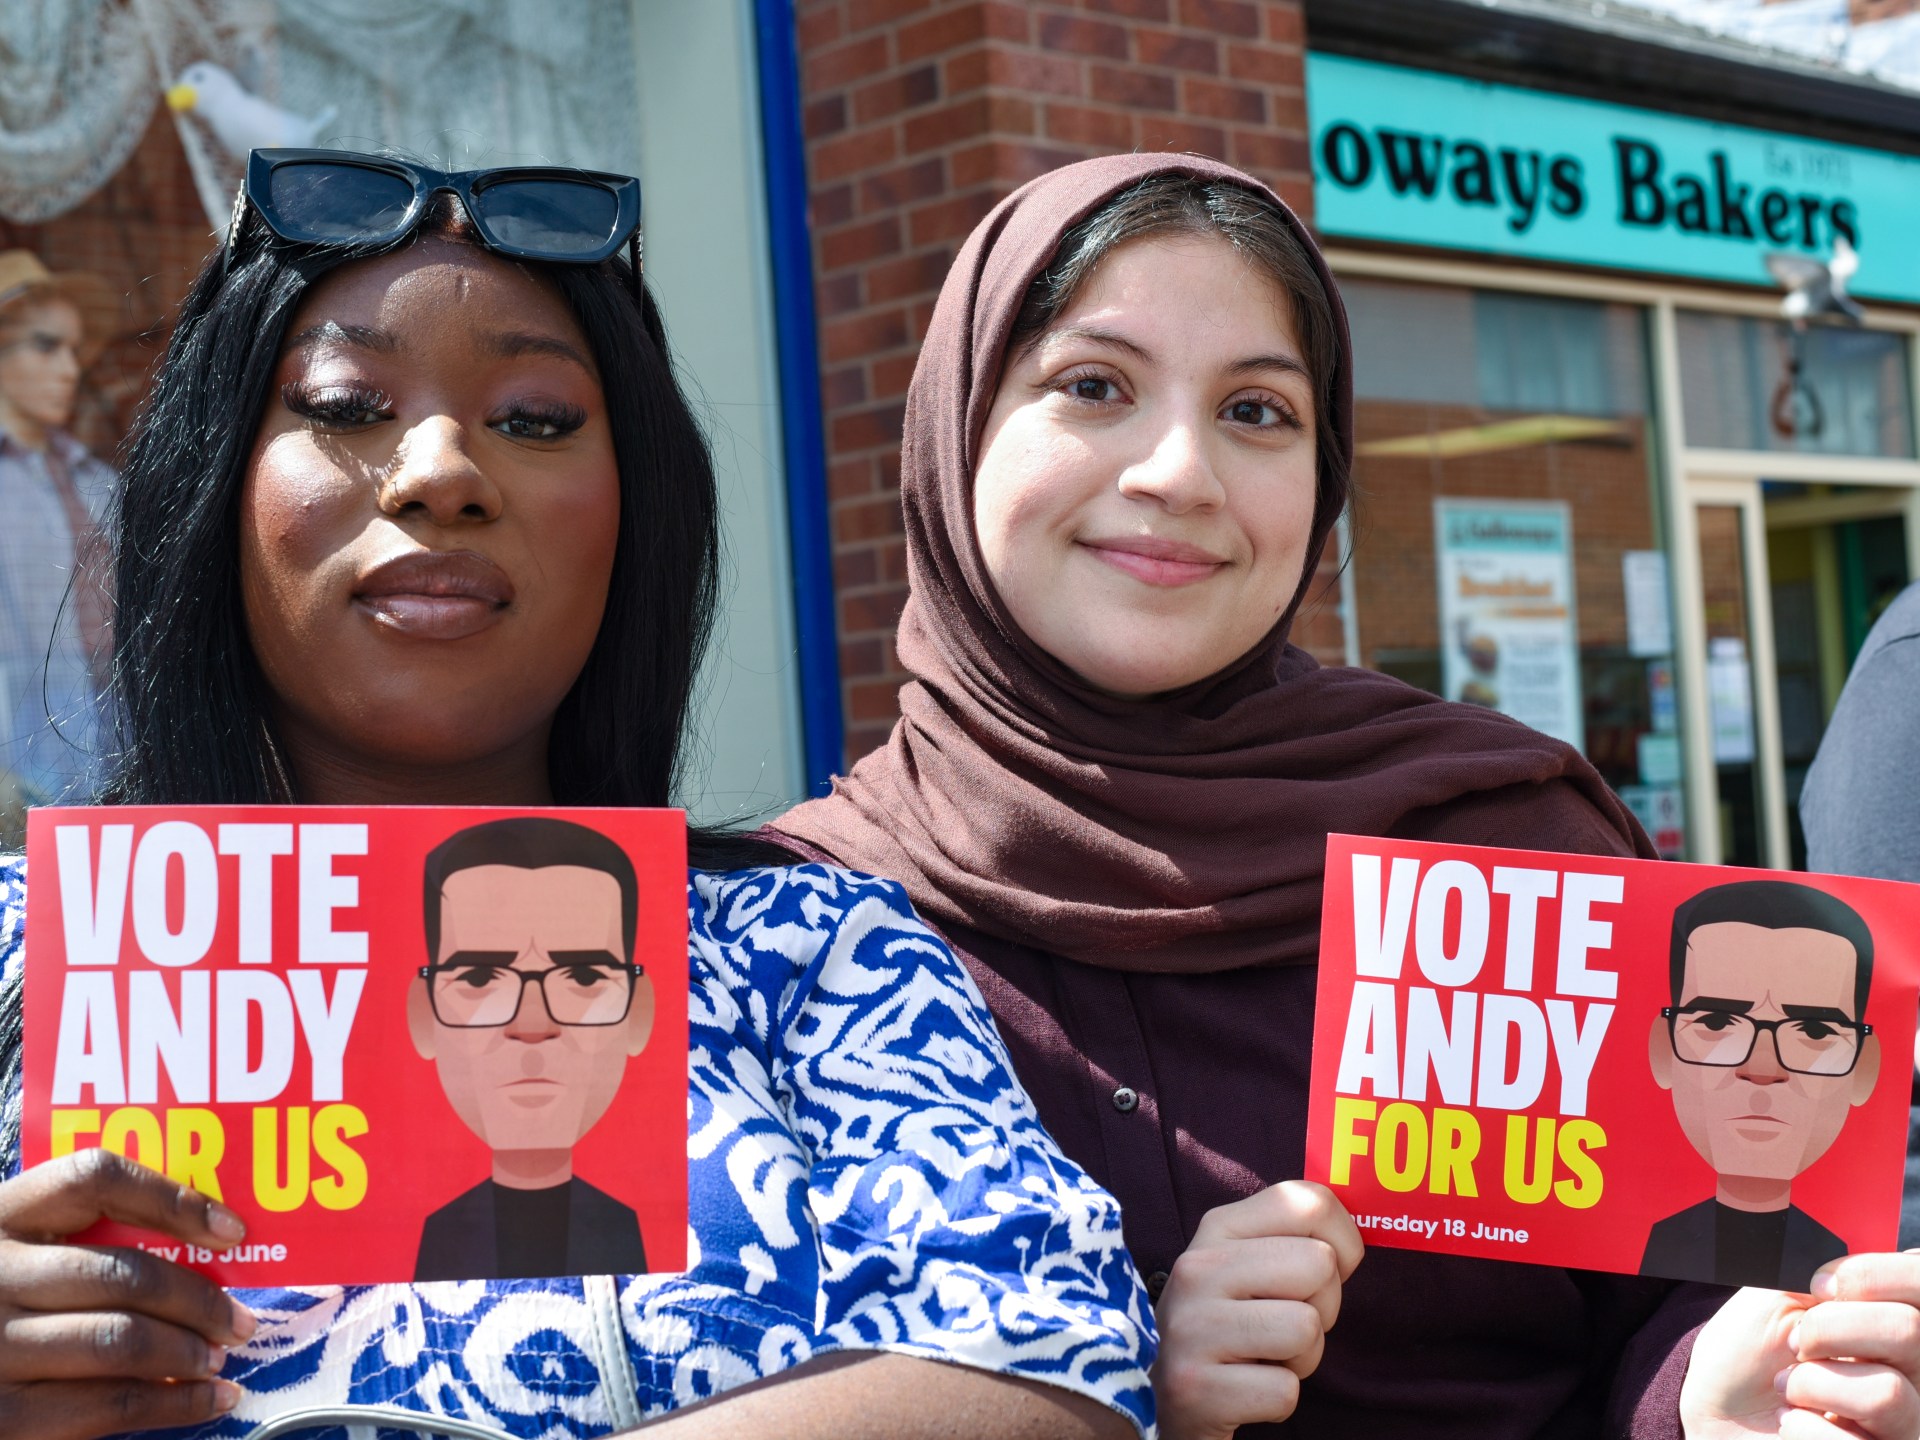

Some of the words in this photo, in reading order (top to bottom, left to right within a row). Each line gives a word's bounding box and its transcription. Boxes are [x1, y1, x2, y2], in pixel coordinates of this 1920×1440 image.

[1319, 121, 1586, 235] oways
[1612, 136, 1858, 249] Bakers
[54, 820, 370, 968] VOTE
[1351, 853, 1626, 1001] VOTE
[50, 968, 369, 1106] ANDY
[1334, 980, 1617, 1118] ANDY
[252, 1103, 370, 1213] US
[1328, 1096, 1483, 1200] FOR
[1502, 1113, 1609, 1211] US
[218, 1243, 288, 1264] June
[1350, 1213, 1439, 1240] ursday
[1443, 1217, 1467, 1238] 18
[1470, 1222, 1530, 1245] June
